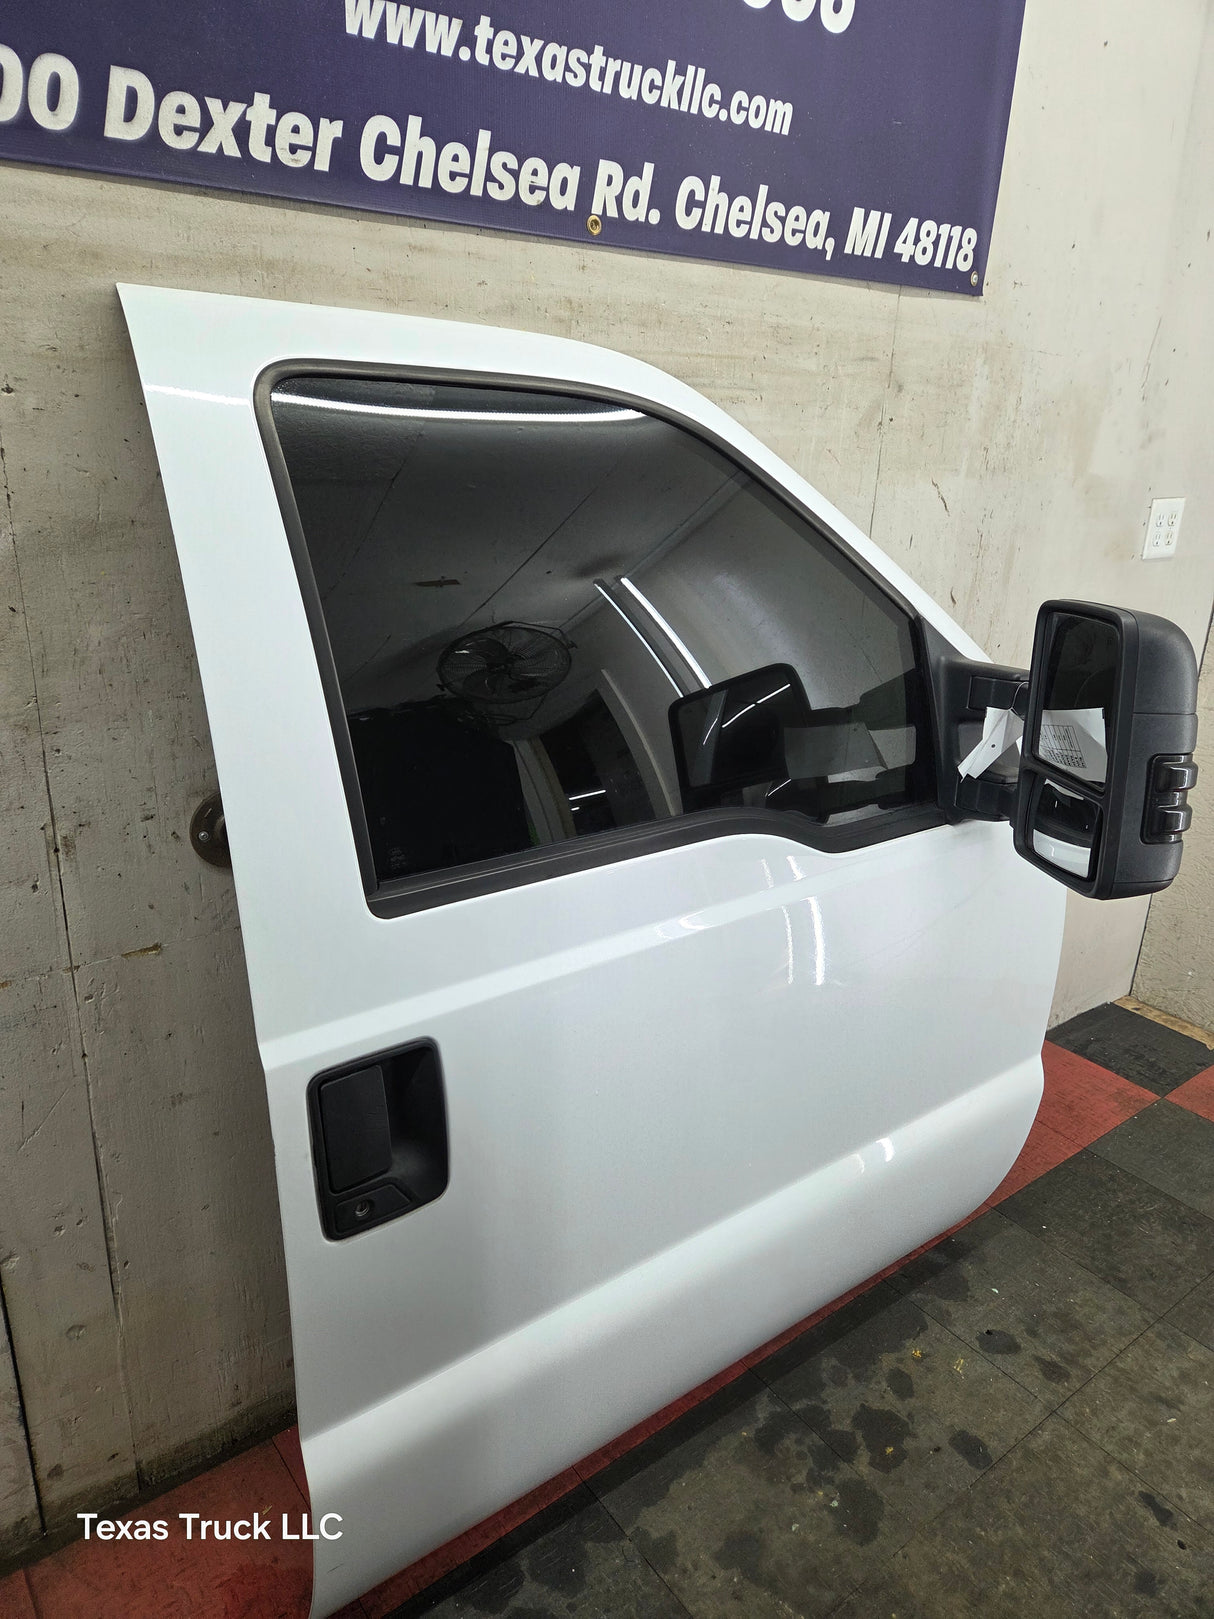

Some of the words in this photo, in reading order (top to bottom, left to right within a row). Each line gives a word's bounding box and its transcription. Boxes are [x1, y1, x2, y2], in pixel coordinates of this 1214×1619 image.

[344, 0, 794, 136] www.texastruckllc.com
[103, 64, 344, 173] Dexter
[359, 114, 581, 213] Chelsea
[591, 158, 661, 226] Rd.
[674, 174, 836, 261] Chelsea,
[843, 206, 893, 260] MI
[893, 216, 978, 273] 48118
